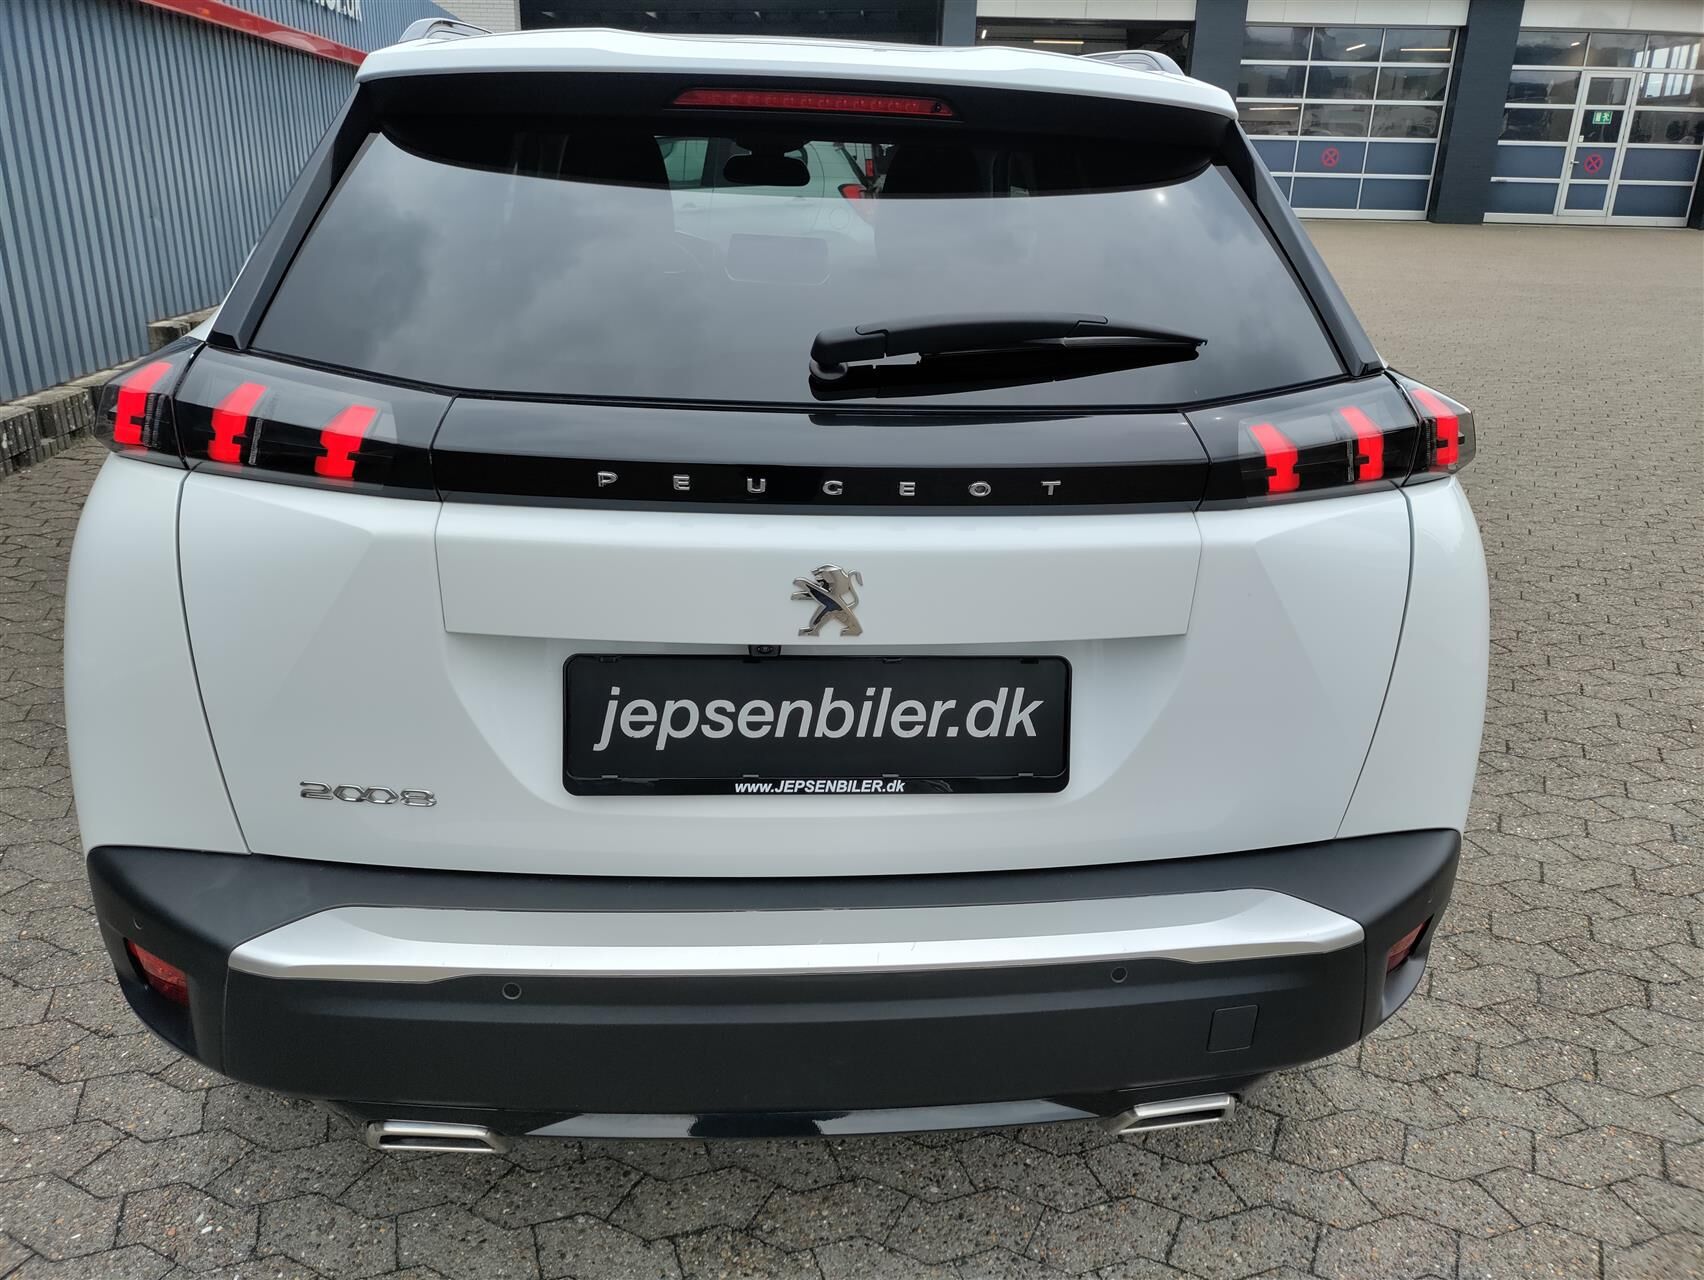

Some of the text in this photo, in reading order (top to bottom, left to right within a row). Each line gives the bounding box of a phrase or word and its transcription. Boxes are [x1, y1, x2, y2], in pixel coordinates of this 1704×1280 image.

[598, 471, 1061, 497] PEUGEOT
[593, 686, 1044, 751] jepsenbiler.dk
[299, 781, 437, 807] 2008
[735, 780, 905, 793] www.JEPSENBILER.dk
